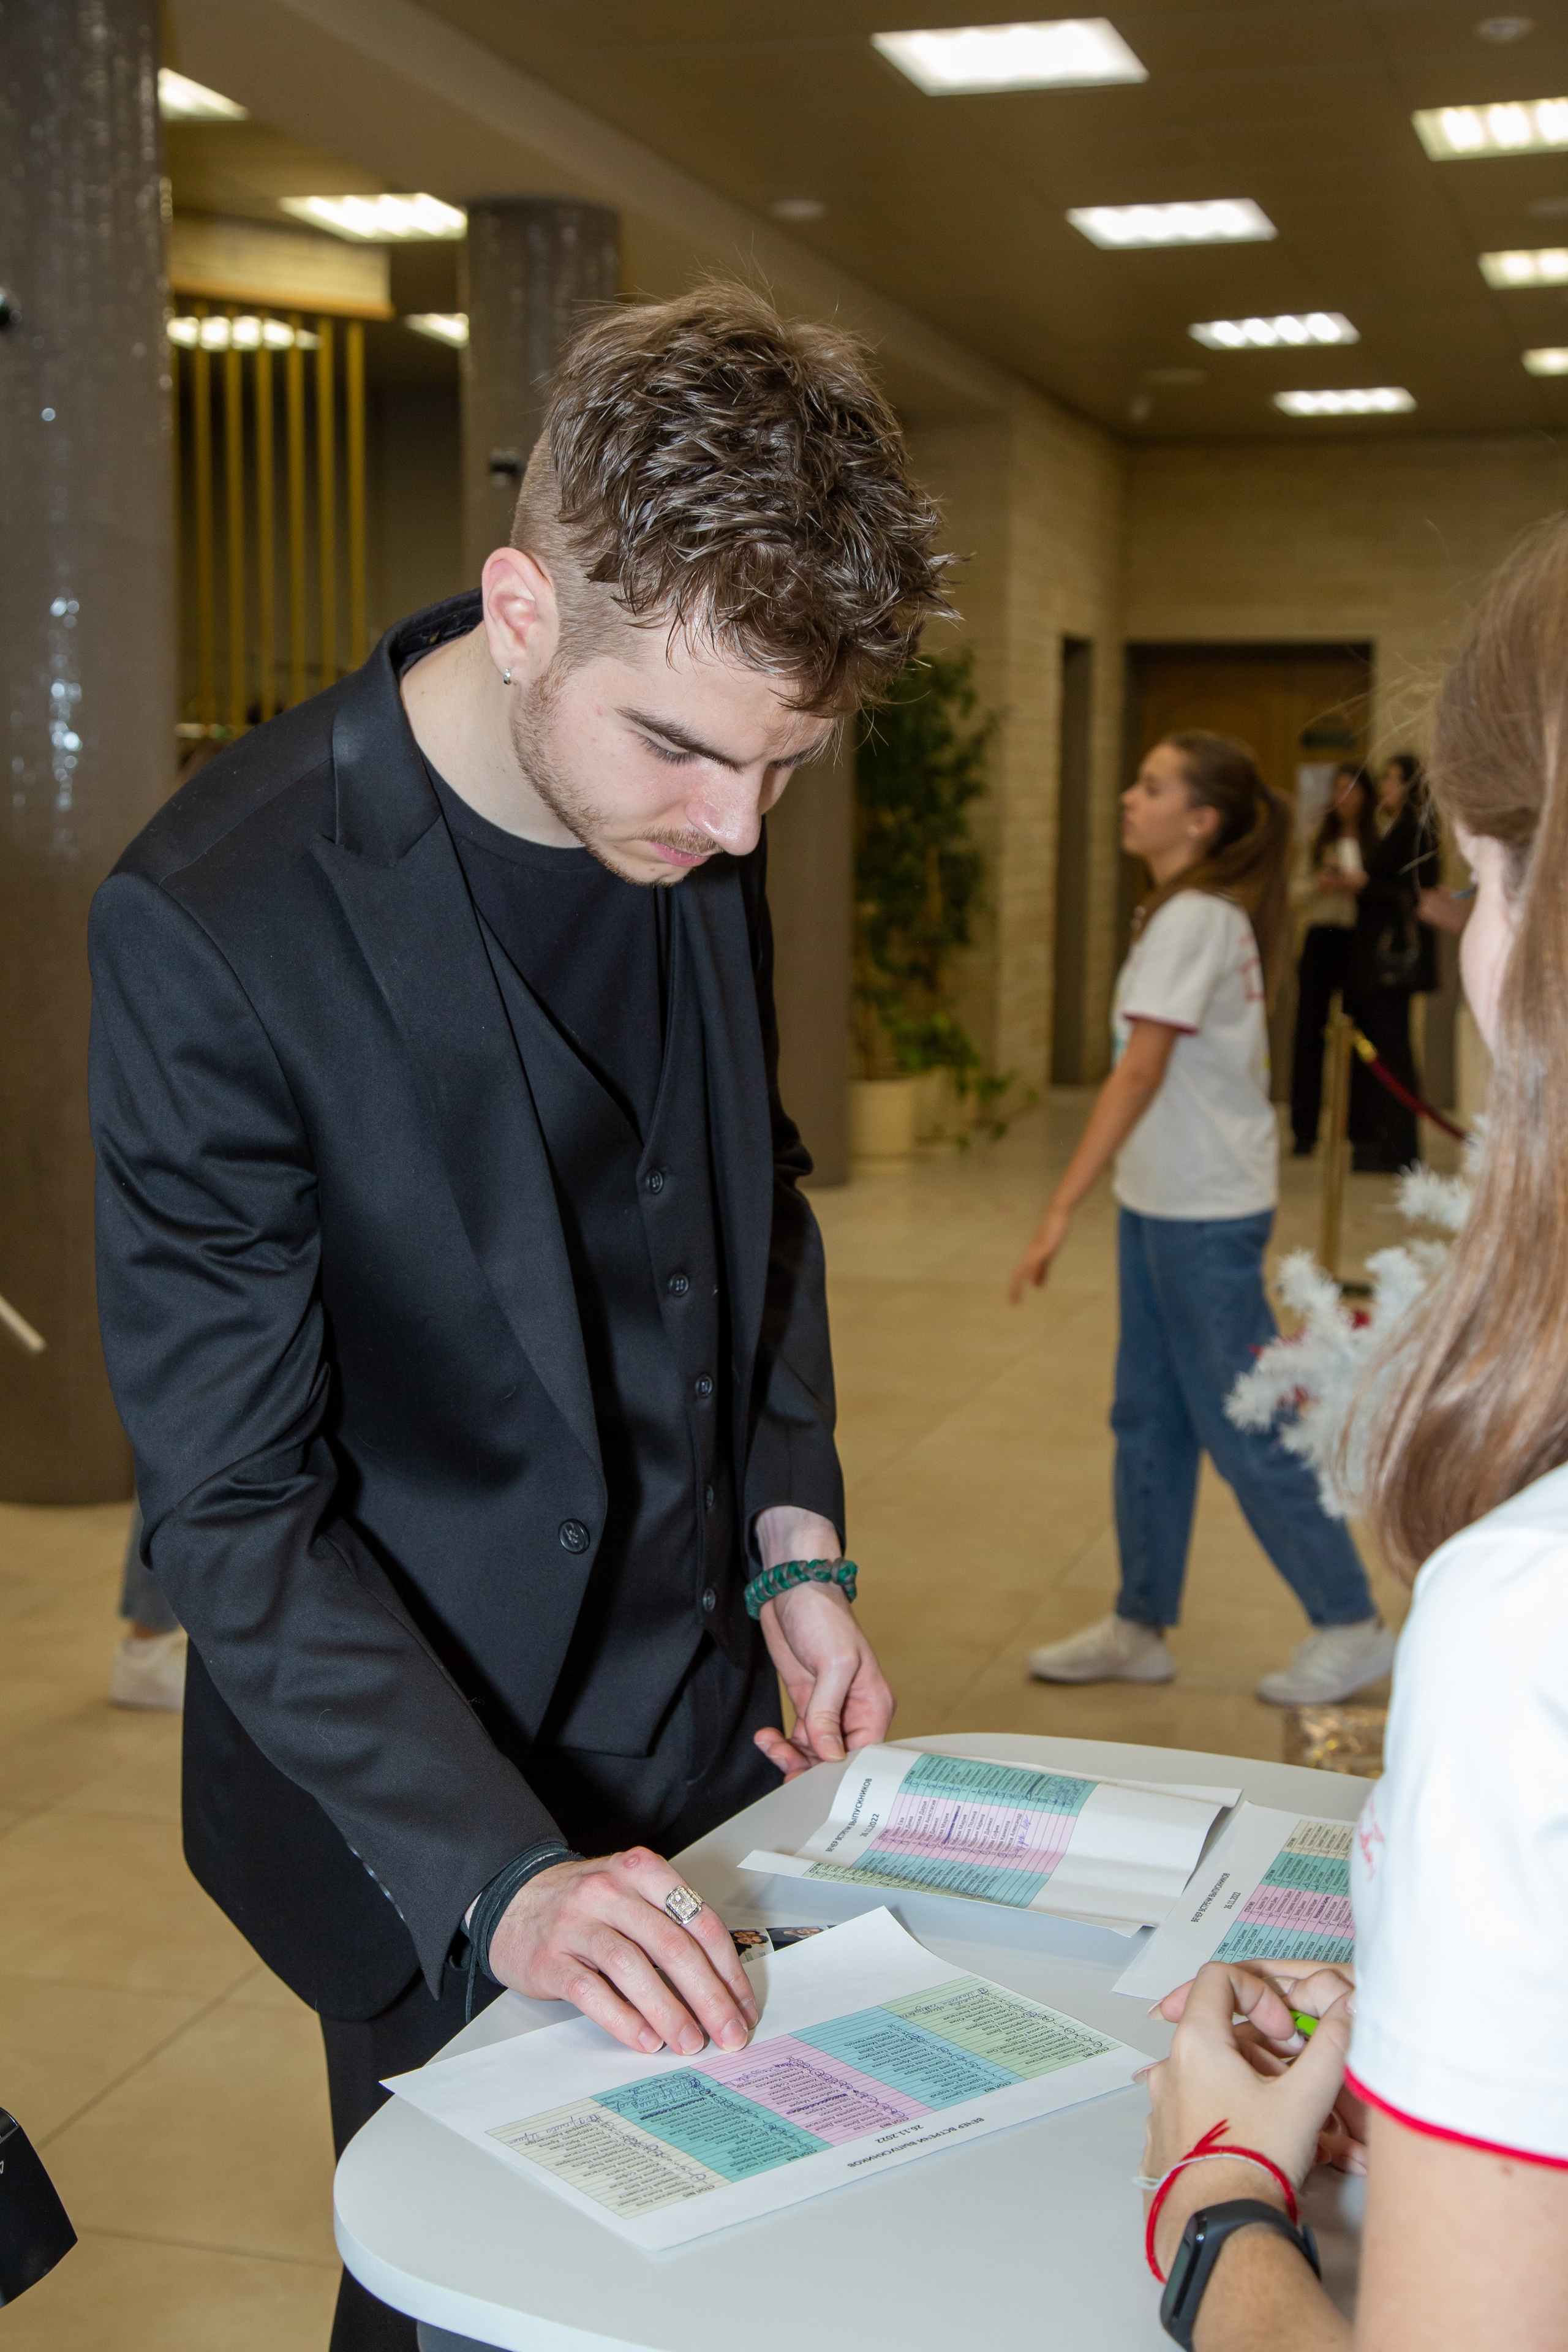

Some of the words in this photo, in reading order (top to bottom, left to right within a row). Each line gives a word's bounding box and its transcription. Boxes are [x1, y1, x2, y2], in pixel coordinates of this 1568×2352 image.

[826, 1840, 838, 1852] ВЕЧЕР
[835, 1826, 851, 1841] ВСТРЕЧИ
[848, 1778, 872, 1825] ВЫПУСКНИКОВ
[860, 1813, 879, 1836] 26.11.2022
[1191, 1912, 1202, 1922] ВЕЧЕР
[1198, 1897, 1212, 1912] ВСТРЕЧИ
[1208, 1872, 1230, 1897] ВЫПУСКНИКОВ
[1223, 1891, 1241, 1909] 26.11.2022
[943, 2010, 970, 2020] Анастасия
[971, 2013, 993, 2022] Андрей
[997, 2015, 1025, 2025] Рощенко
[965, 2019, 994, 2030] Екатерина
[1016, 2021, 1039, 2031] Павлова
[1026, 2025, 1047, 2034] Осипов
[865, 2030, 892, 2040] Геворкян
[1004, 2033, 1027, 2041] Георгий
[1028, 2029, 1055, 2040] Никитина
[887, 2041, 913, 2050] Шалаева
[890, 2044, 920, 2055] Шакирова
[1003, 2043, 1031, 2054] Екатерина
[1017, 2045, 1045, 2055] Анастасия
[1041, 2040, 1077, 2052] Кондратьева
[1050, 2043, 1084, 2056] Большакова
[857, 2049, 888, 2060] Екатерина
[899, 2048, 926, 2058] Холодова
[910, 2051, 934, 2060] Уханова
[872, 2057, 900, 2067] Вероника
[1025, 2054, 1052, 2064] Кристина
[893, 2064, 916, 2072] Наташа
[903, 2066, 929, 2075] Варвара
[942, 2065, 963, 2075] Львова
[782, 2070, 804, 2079] Алиева
[788, 2074, 811, 2082] Нурова
[947, 2070, 971, 2079] Кузубов
[736, 2076, 768, 2088] Александр
[755, 2078, 782, 2088] Камилла
[791, 2078, 816, 2087] Хоменко
[952, 2077, 986, 2089] Годзиладзе
[963, 2081, 993, 2092] Золотарев
[767, 2086, 791, 2095] Даниил
[929, 2089, 953, 2098] Георгий
[941, 2090, 963, 2100] Даниил
[771, 2092, 794, 2100] Карина
[775, 2096, 799, 2105] Полина
[680, 2101, 713, 2113] Султанова
[788, 2098, 810, 2107] Мария
[825, 2097, 854, 2108] Годунова
[638, 2103, 669, 2114] Вероника
[804, 2106, 826, 2115] Мария
[819, 2106, 842, 2116] Даниил
[835, 2105, 869, 2117] Бондарева
[650, 2112, 680, 2122] Кристина
[660, 2114, 693, 2125] Елизавета
[701, 2112, 734, 2124] Орешкина
[860, 2112, 883, 2121] Блинов
[864, 2116, 891, 2126] Бадалян
[669, 2117, 699, 2128] Василиса
[804, 2116, 835, 2128] Анастасия
[814, 2122, 834, 2131] Дарья
[958, 2117, 984, 2128] ВЕЧЕР
[562, 2127, 598, 2139] Сидоренко
[668, 2123, 700, 2135] Анастасия
[686, 2125, 713, 2135] Валерия
[875, 2125, 923, 2143] 26.11.2022
[524, 2132, 563, 2146] Александра
[688, 2131, 714, 2141] Полина
[704, 2133, 728, 2142] Никита
[715, 2135, 739, 2144] Даниил
[916, 2127, 957, 2143] ВСТРЕЧИ
[549, 2139, 580, 2150] Ярослава
[749, 2136, 777, 2146] Головин
[563, 2146, 596, 2158] Анастасия
[600, 2143, 625, 2152] Орлова
[726, 2145, 750, 2154] Сергей
[592, 2147, 631, 2160] Бондарева
[732, 2150, 752, 2159] Алина
[847, 2141, 917, 2166] ВЫПУСКНИКОВ
[729, 2157, 756, 2167] Варвара
[736, 2161, 763, 2171] Георгий
[582, 2164, 616, 2177] Анастасия
[605, 2167, 627, 2176] Настя
[614, 2171, 636, 2180] София
[609, 2176, 642, 2188] Анастасия
